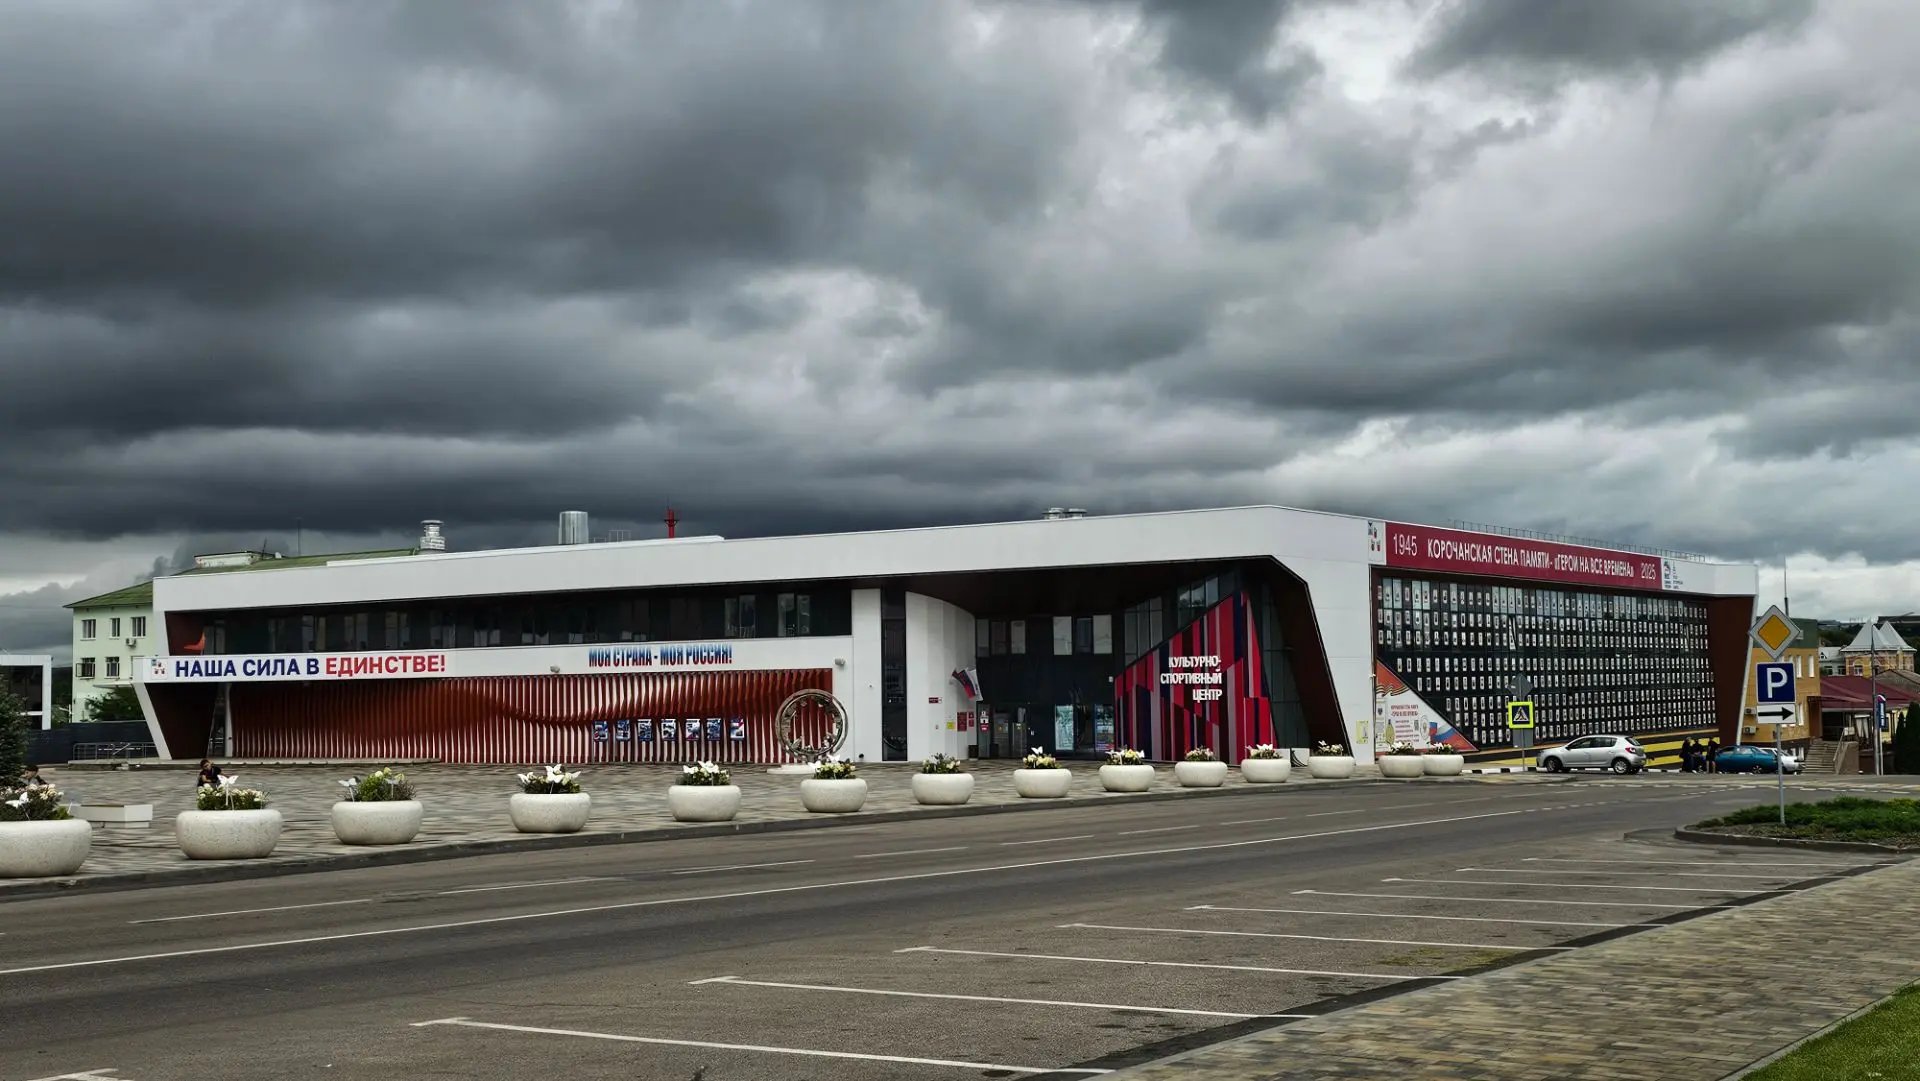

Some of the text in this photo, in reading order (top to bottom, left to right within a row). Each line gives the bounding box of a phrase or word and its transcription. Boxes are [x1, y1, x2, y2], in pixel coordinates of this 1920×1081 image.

[1393, 533, 1418, 556] 1945
[1427, 538, 1492, 563] КОРОЧАНСКАЯ
[1494, 545, 1519, 566] СТЕНА
[1579, 556, 1590, 573] НА
[1590, 557, 1603, 575] ВСЕ
[1603, 560, 1635, 578] ВРЕМЕНА»
[1640, 562, 1657, 580] 2025
[175, 654, 446, 678] НАША СИЛА В ЕДИНСТВЕ!
[588, 646, 611, 667] МОЯ
[613, 645, 653, 667] СТРАНА
[660, 644, 684, 666] МОЯ
[686, 642, 733, 665] РОССИЯ!
[1168, 655, 1222, 668] КУЛЬТУРНО-
[1160, 668, 1222, 684] СПОРТИВНЫЙ
[1766, 666, 1788, 699] P
[1192, 688, 1223, 703] ЦЕНТР
